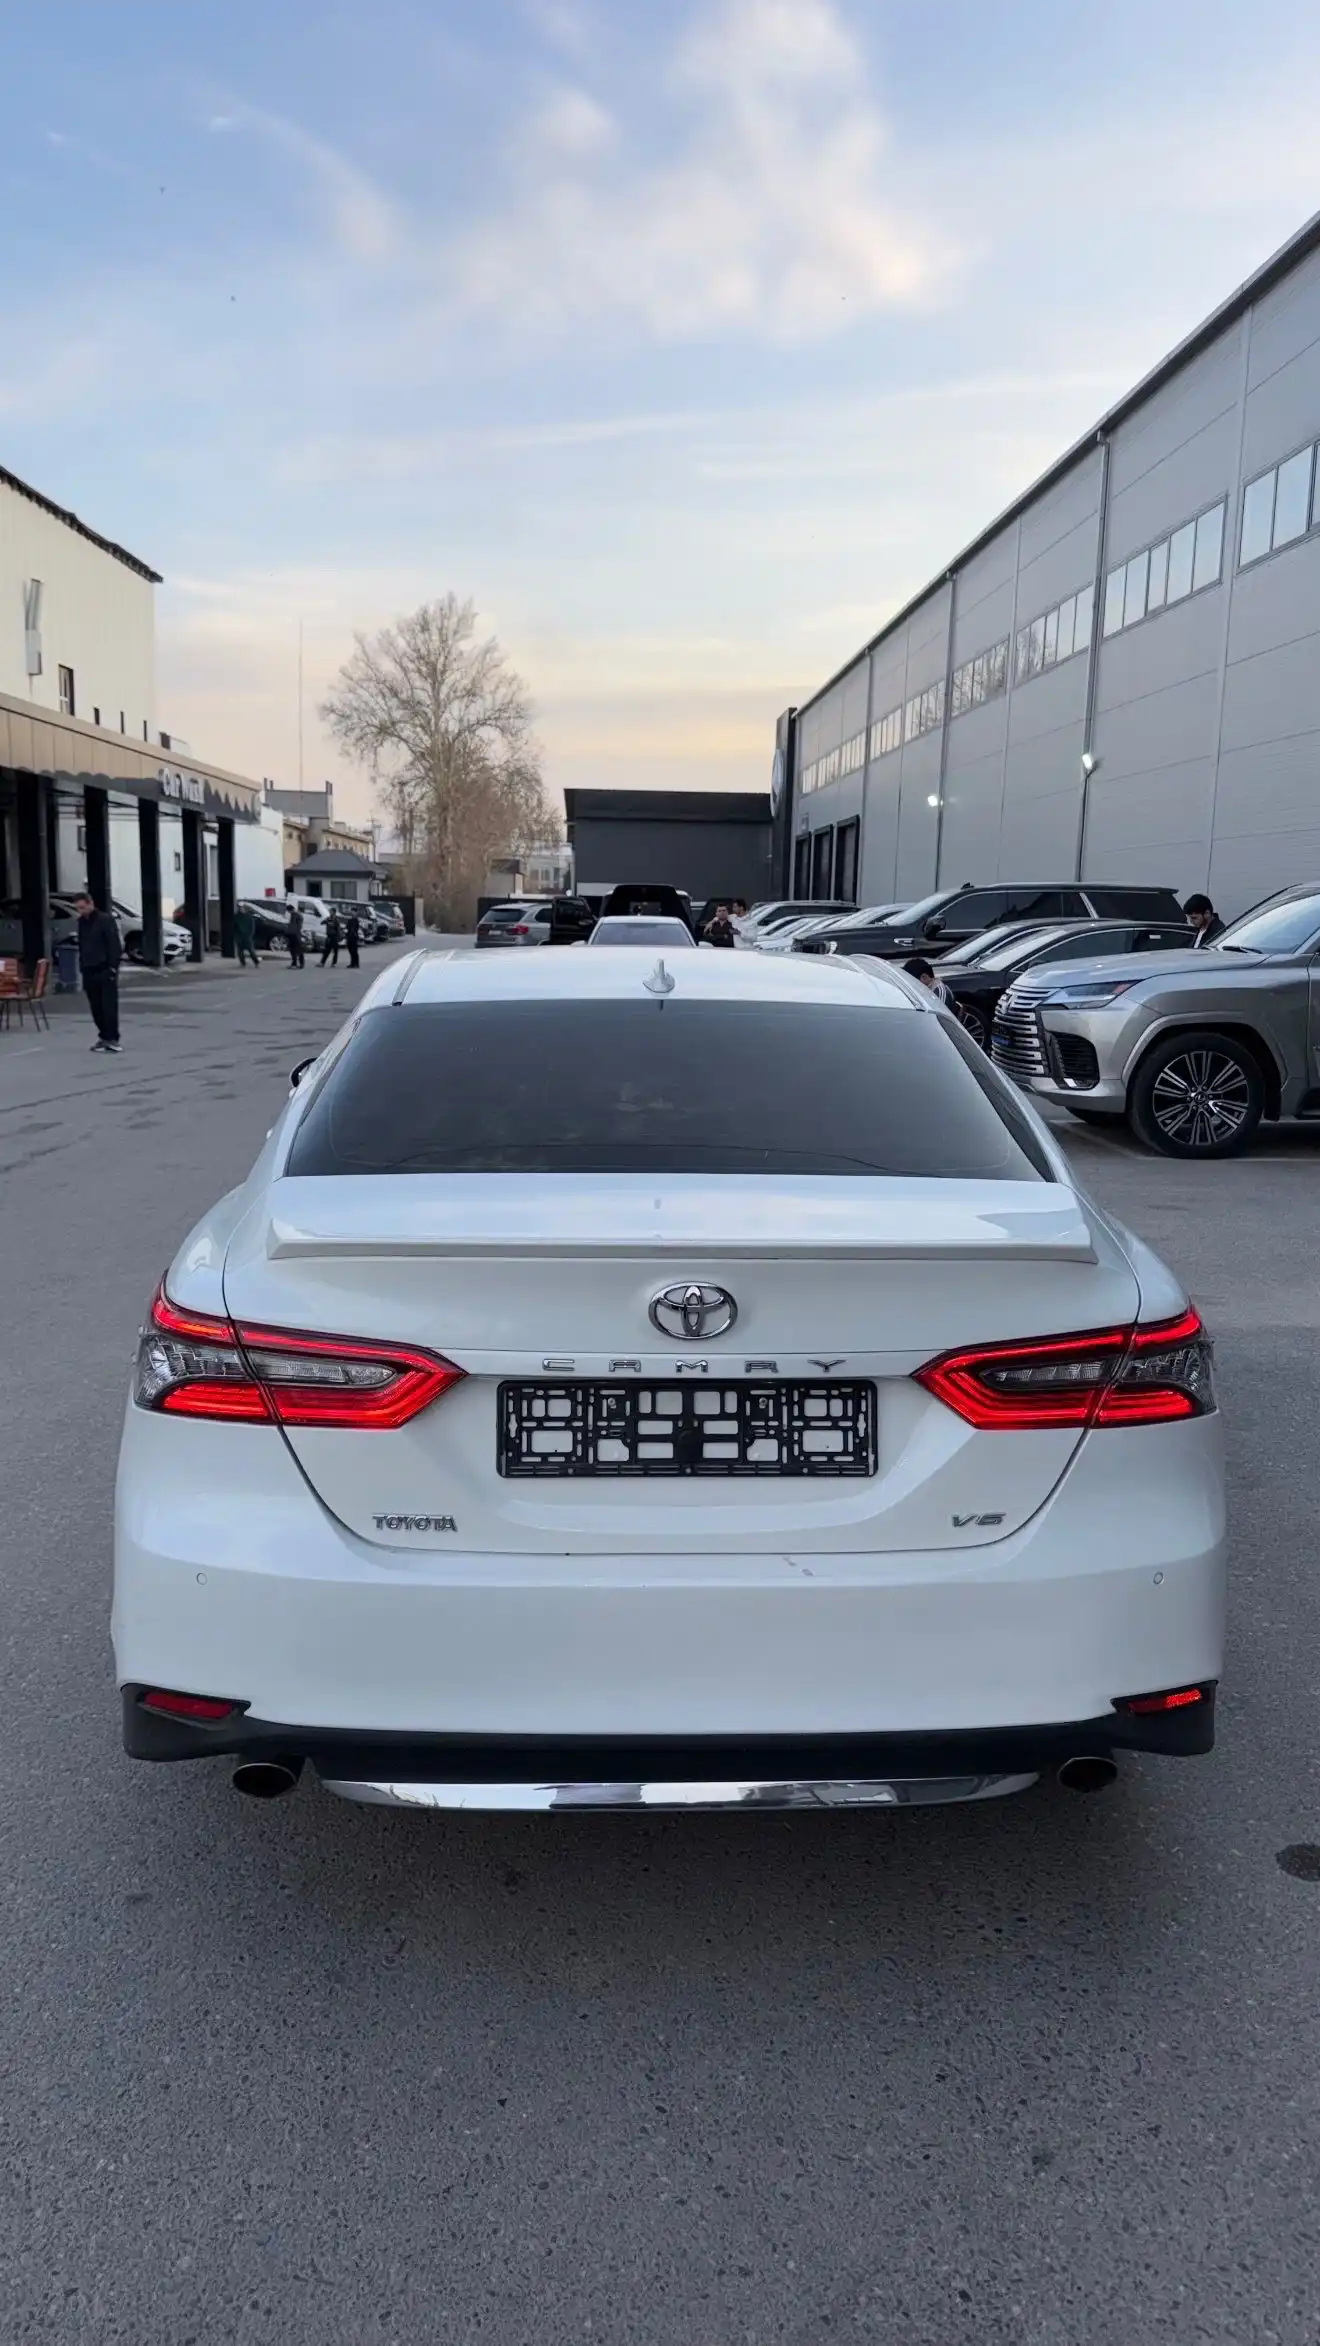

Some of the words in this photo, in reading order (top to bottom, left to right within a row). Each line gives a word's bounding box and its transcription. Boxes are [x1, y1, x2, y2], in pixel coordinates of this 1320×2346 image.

[541, 1357, 848, 1374] CAMRY
[372, 1513, 458, 1532] TOYOTA
[952, 1512, 1007, 1527] V6
